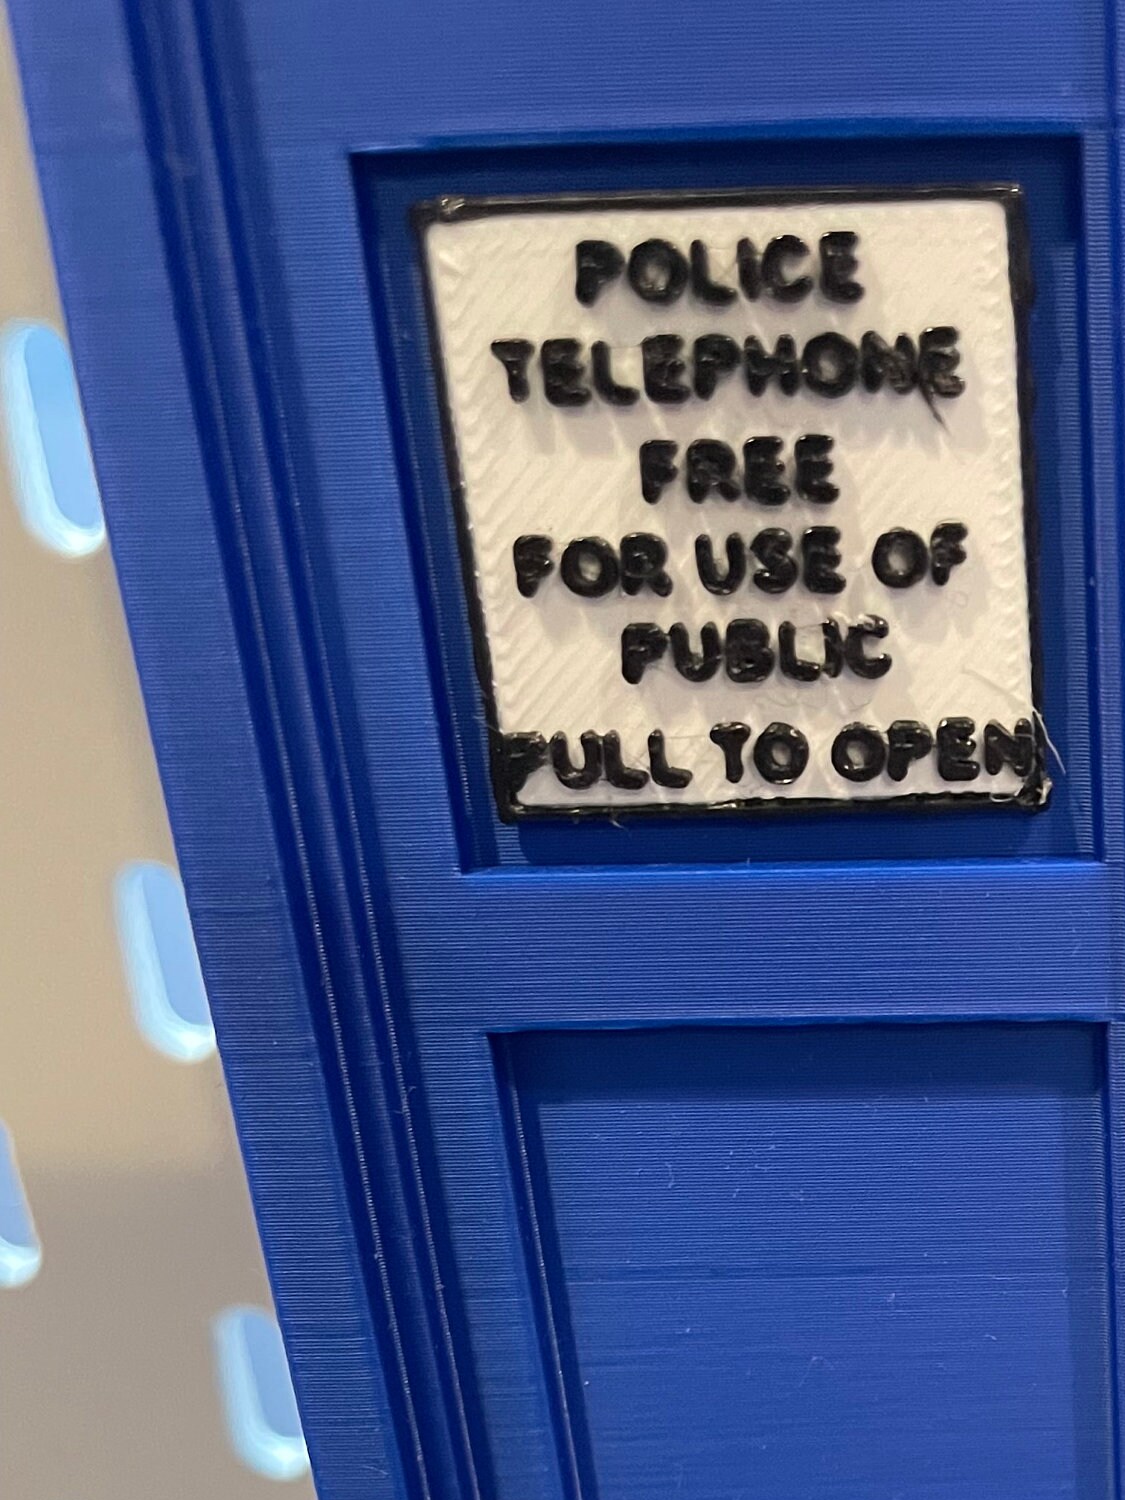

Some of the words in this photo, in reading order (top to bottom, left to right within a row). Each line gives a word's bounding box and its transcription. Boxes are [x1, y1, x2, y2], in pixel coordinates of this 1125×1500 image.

[575, 231, 864, 307] POLICE
[490, 326, 966, 407] TELEPHONE
[639, 434, 839, 504] FREE
[513, 532, 673, 597] FOR
[695, 526, 847, 595] USE
[871, 522, 968, 588] OF
[621, 615, 892, 684] PUBLIC
[500, 729, 693, 797] PULL
[710, 721, 809, 785] TO
[831, 717, 1034, 784] OPEN
